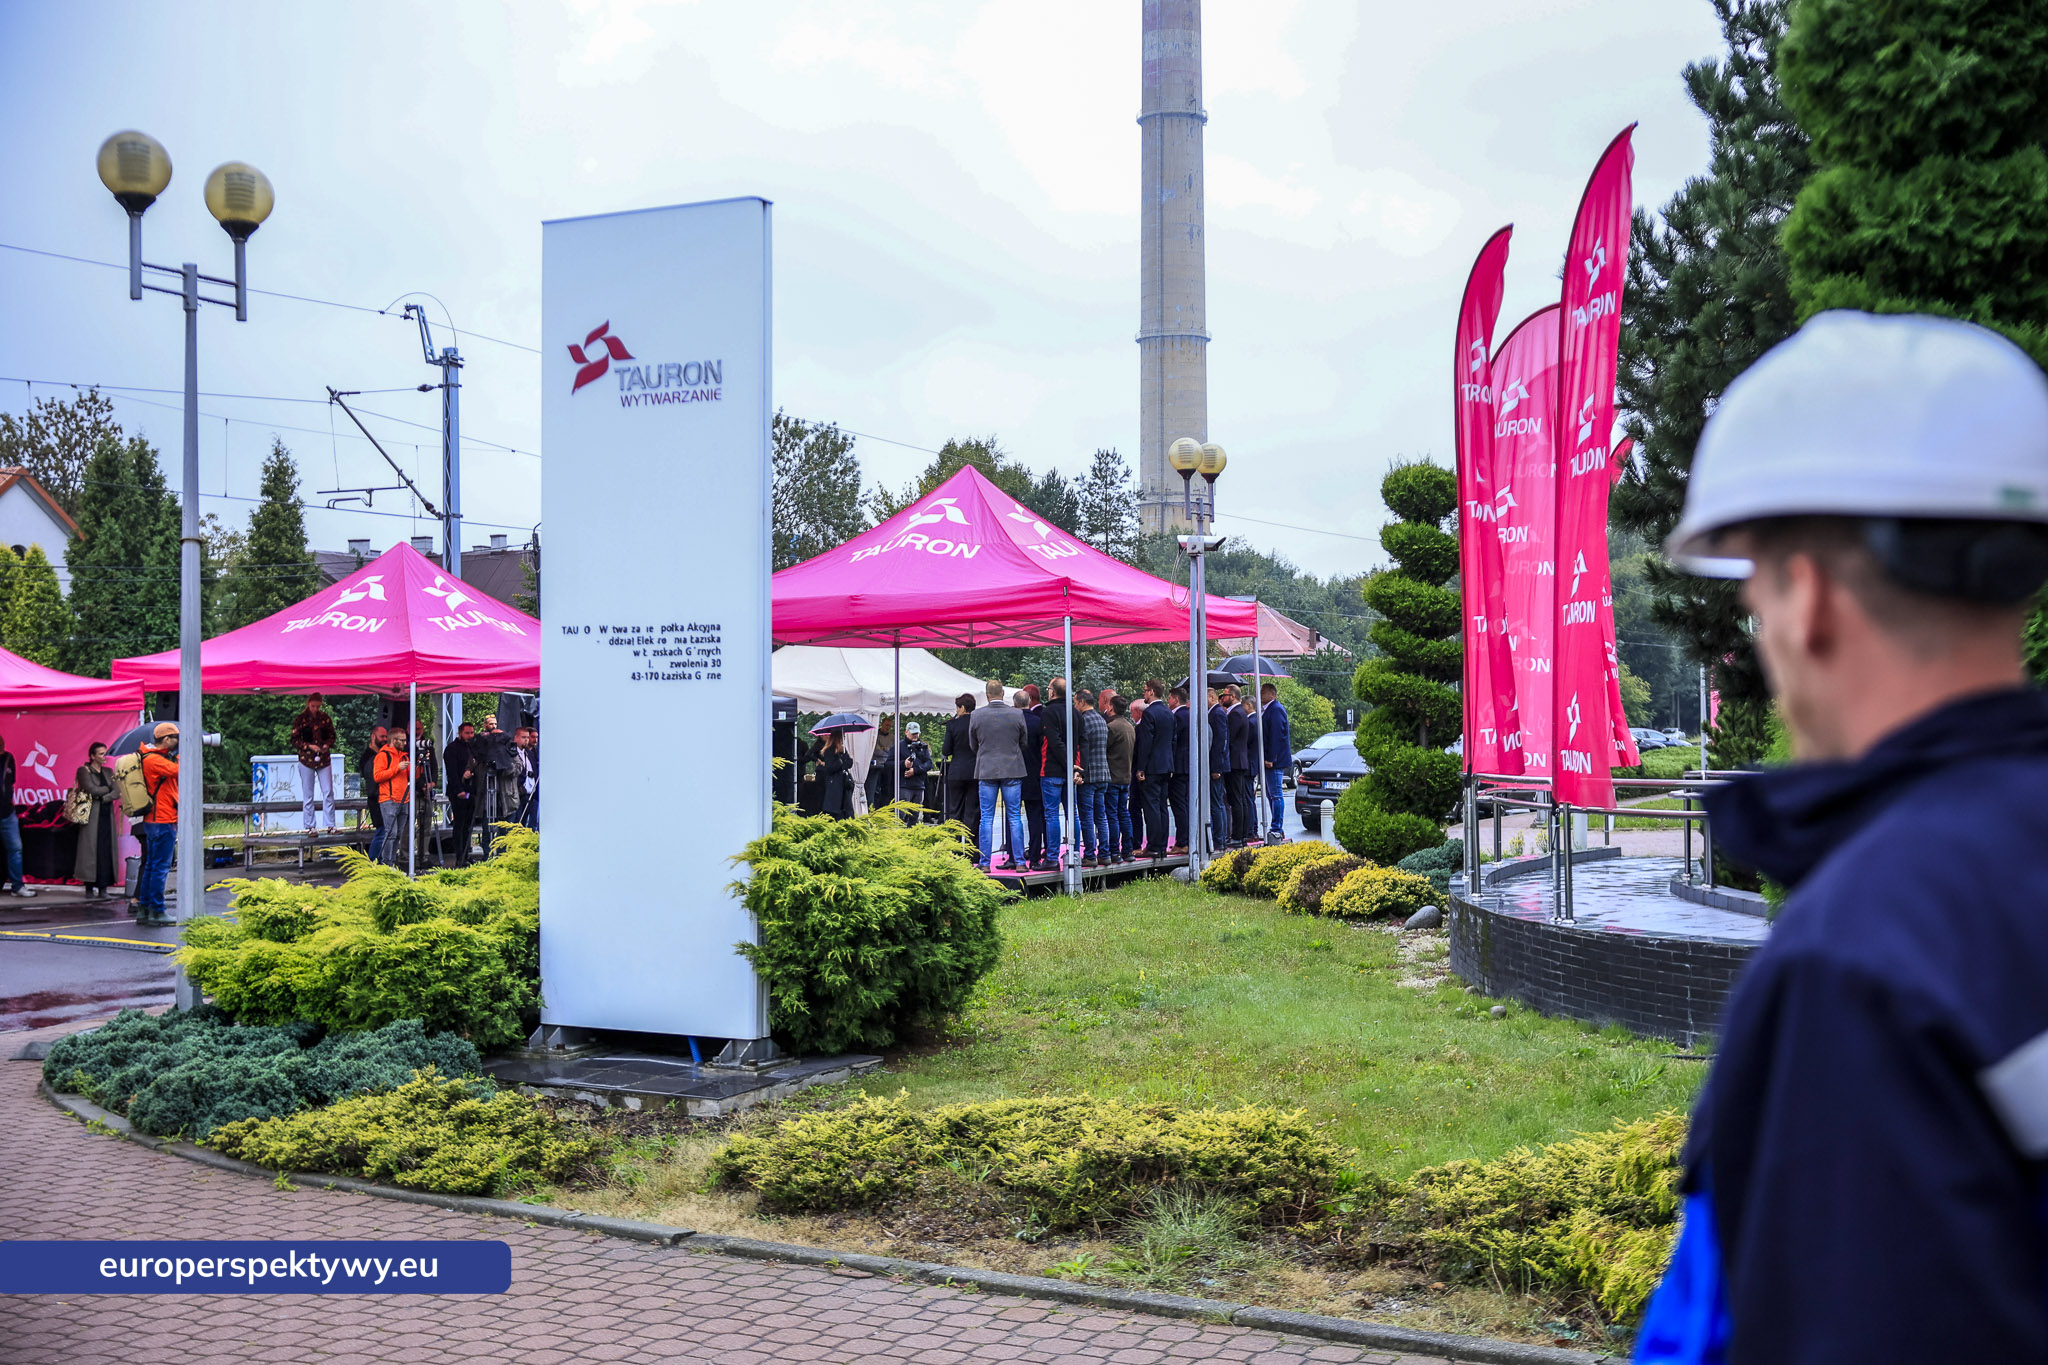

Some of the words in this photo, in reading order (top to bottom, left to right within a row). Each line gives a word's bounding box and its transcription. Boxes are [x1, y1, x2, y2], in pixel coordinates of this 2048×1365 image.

[614, 359, 722, 391] TAURON
[620, 387, 722, 408] WYTWARZANIE
[849, 533, 981, 563] TAURON
[280, 611, 387, 633] TAURON
[427, 610, 528, 636] TAURON
[562, 625, 591, 635] TAUO
[661, 622, 684, 634] połka
[608, 636, 634, 646] ddział
[643, 647, 682, 657] Łziskach
[685, 645, 721, 657] Grnych
[711, 658, 721, 668] 30
[631, 671, 659, 680] 43-170
[695, 670, 721, 680] Grne
